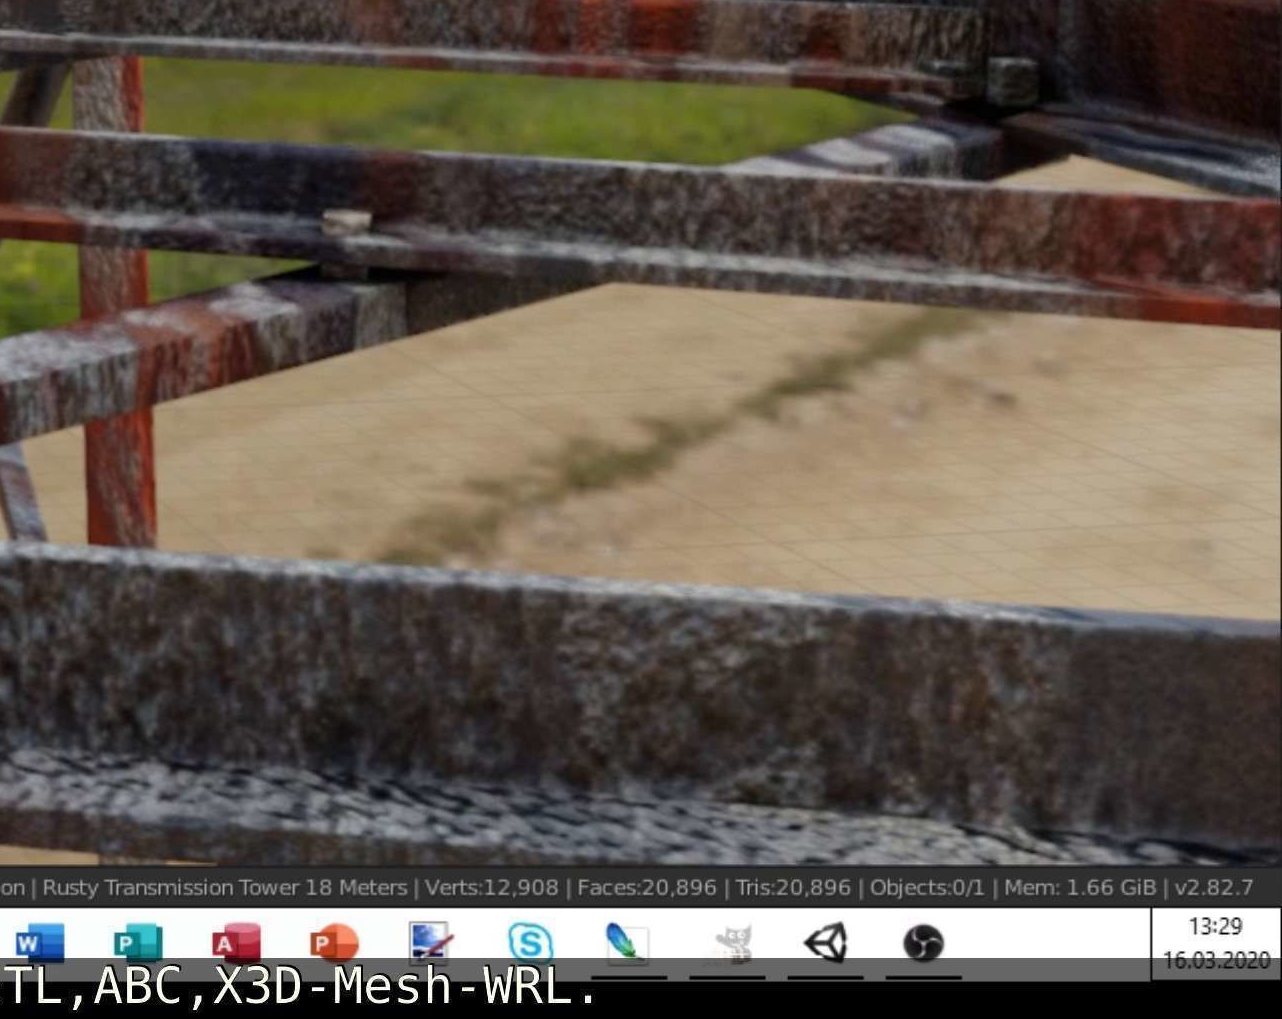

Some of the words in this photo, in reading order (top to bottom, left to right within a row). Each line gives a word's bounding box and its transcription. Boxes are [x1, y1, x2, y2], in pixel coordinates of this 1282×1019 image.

[43, 878, 100, 900] Rusty
[103, 878, 234, 896] Transmission
[237, 878, 301, 896] Tower
[306, 878, 332, 896] 18
[339, 878, 408, 896] Meters
[424, 878, 559, 898] Verts:12,908
[578, 878, 717, 898] Faces:20,896
[734, 878, 851, 898] Tris:20,896
[870, 877, 985, 900] Objects:0/1
[1005, 878, 1060, 896] Mem:
[1067, 878, 1114, 896] 1.66
[1120, 878, 1157, 896] GiB
[1174, 878, 1254, 896] v2.82.7
[1189, 916, 1243, 936] 13:29
[1163, 950, 1272, 970] 16.03.2020
